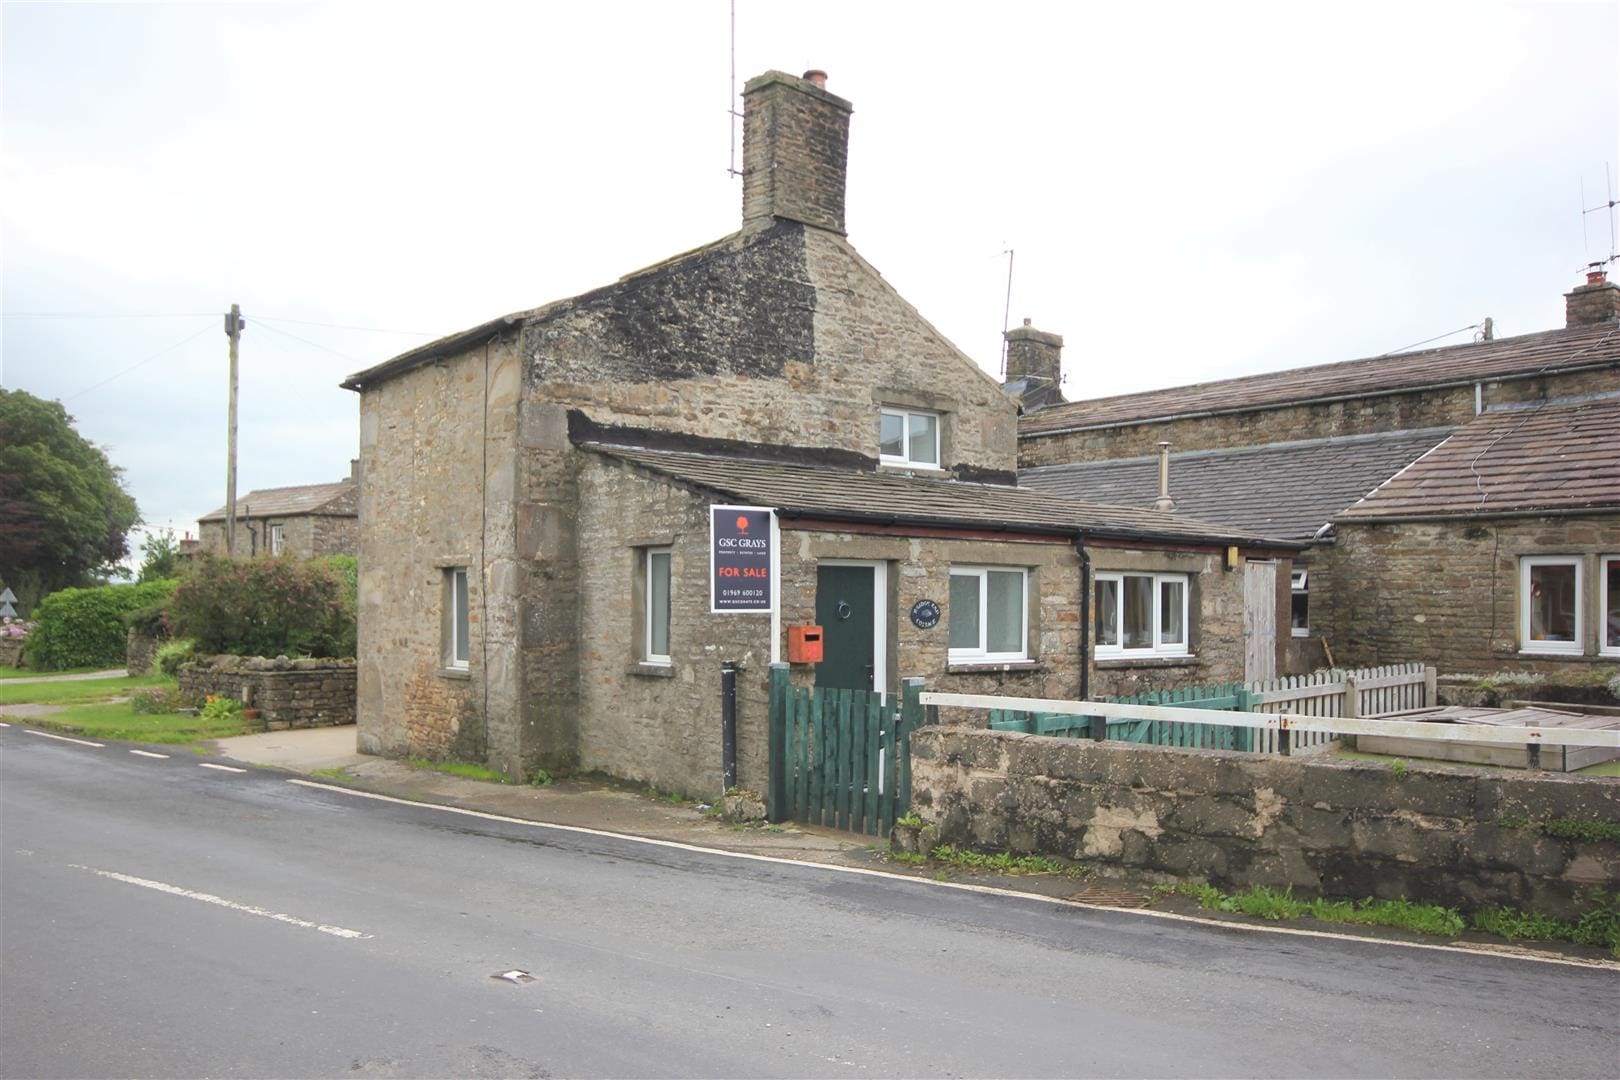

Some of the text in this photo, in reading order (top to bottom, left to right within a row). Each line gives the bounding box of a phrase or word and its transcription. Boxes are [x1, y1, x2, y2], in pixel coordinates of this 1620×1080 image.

[719, 538, 766, 548] GSC GRAYS
[719, 568, 767, 577] FOR SALE
[742, 589, 763, 597] 600120
